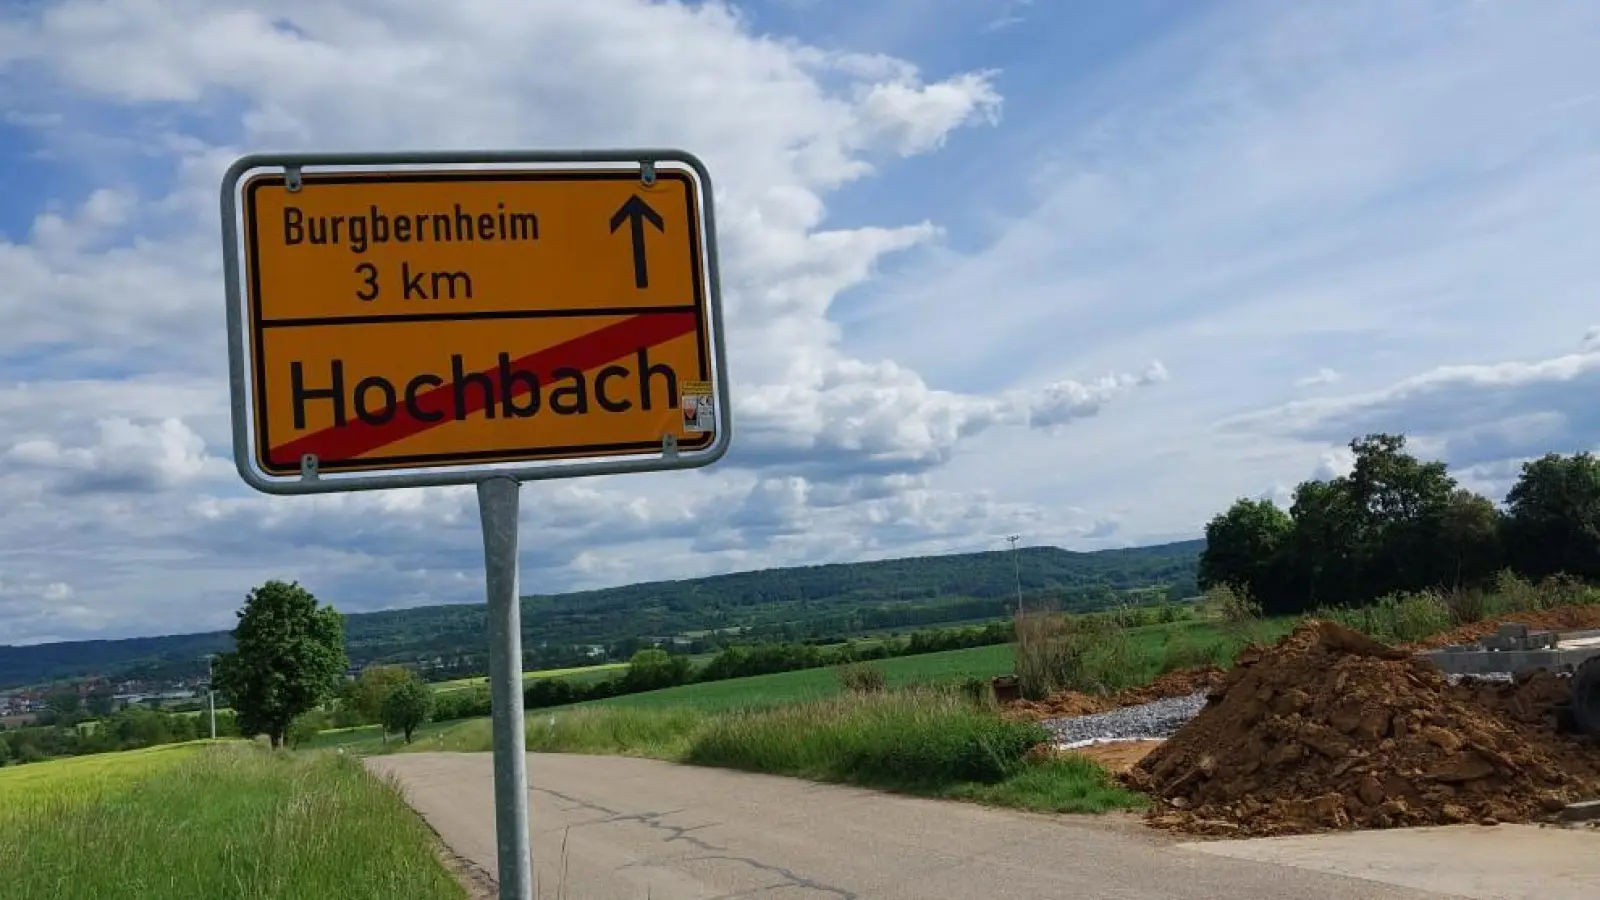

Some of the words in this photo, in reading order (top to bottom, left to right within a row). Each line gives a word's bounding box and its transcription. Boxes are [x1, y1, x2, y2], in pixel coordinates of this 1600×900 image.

[284, 203, 540, 253] Burgbernheim
[354, 263, 379, 301] 3
[402, 261, 473, 300] km
[290, 347, 679, 430] Hochbach
